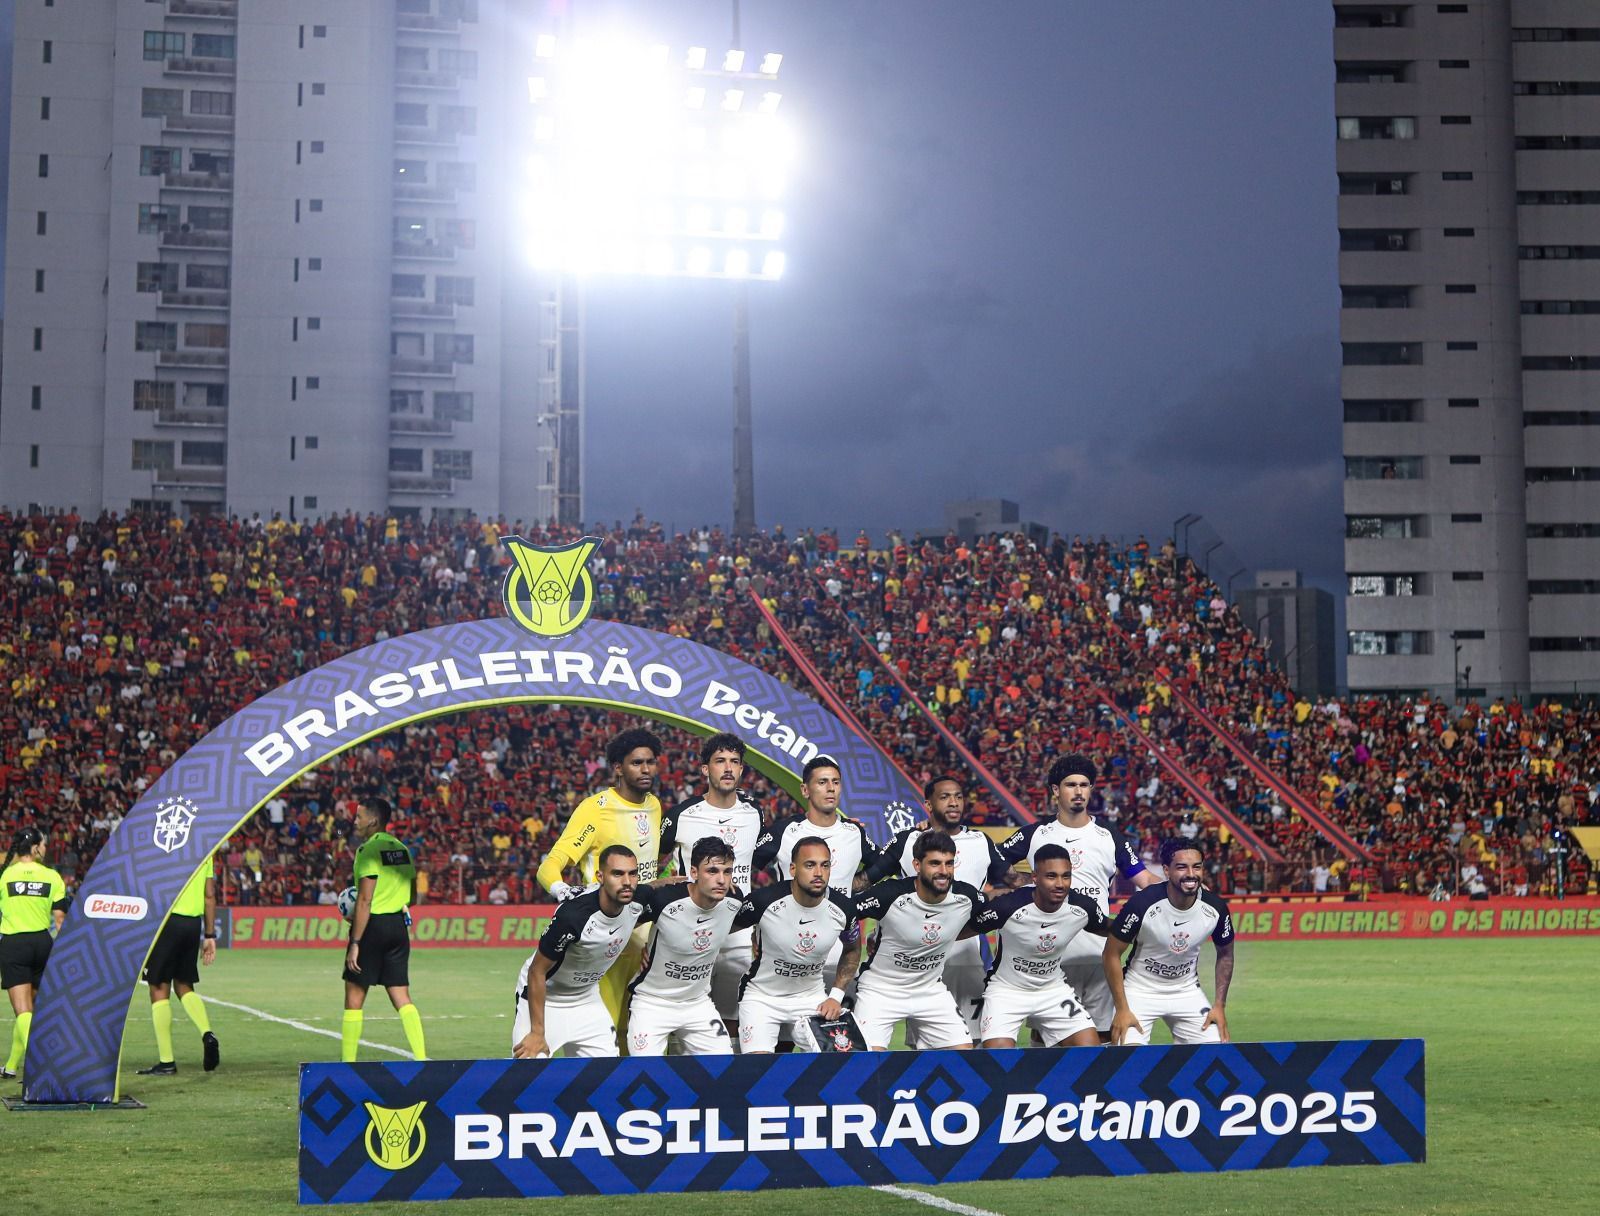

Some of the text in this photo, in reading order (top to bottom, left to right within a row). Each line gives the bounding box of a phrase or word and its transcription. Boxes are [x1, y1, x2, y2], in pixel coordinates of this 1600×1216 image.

[243, 646, 838, 777] BRASILEIRÃO Betan
[579, 824, 595, 843] bmg
[27, 882, 43, 890] CBF
[91, 900, 140, 915] Betano
[861, 898, 881, 910] bmg
[980, 911, 999, 922] bmg
[1123, 913, 1140, 930] bmg
[1278, 911, 1294, 933] E
[1300, 911, 1405, 933] CINEMAS
[1413, 909, 1447, 932] DO
[1500, 908, 1600, 931] MAIORES
[233, 917, 256, 942] S
[409, 917, 490, 943] OJAS,
[894, 952, 945, 964] Esportes
[1144, 957, 1194, 971] Esportes
[454, 1089, 1378, 1161] BRASILEIRÃO Betano 2025
